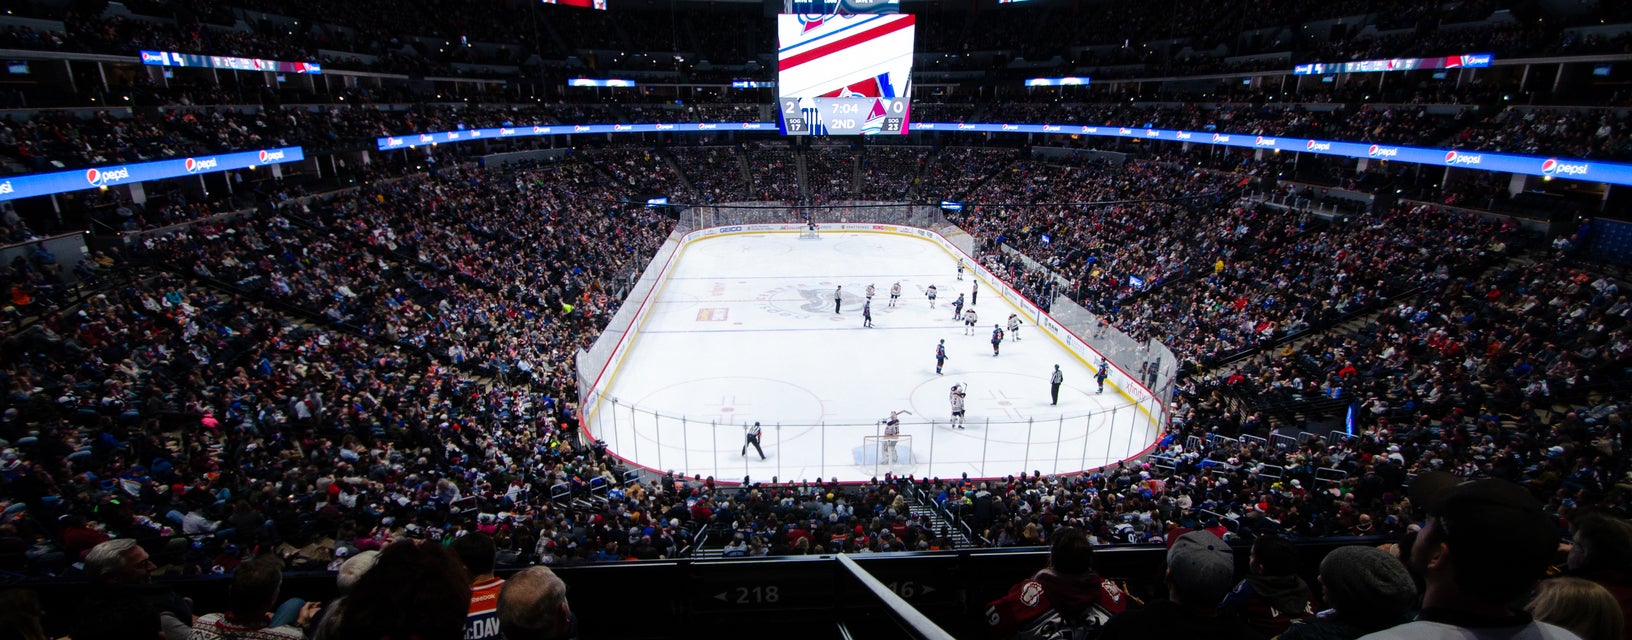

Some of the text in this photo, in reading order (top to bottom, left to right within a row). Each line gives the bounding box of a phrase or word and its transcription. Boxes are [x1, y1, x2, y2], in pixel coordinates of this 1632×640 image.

[786, 101, 795, 114] 2
[831, 104, 858, 114] 7:04
[893, 101, 904, 114] 0
[831, 119, 856, 129] 2ND
[1314, 142, 1330, 151] pepsi
[1377, 147, 1397, 158] pepsi
[196, 157, 217, 170] pepsi
[1456, 153, 1481, 165] pepsi
[102, 167, 129, 183] pepsi
[1556, 162, 1588, 175] pepsi
[1126, 381, 1146, 400] xfinity
[736, 586, 779, 604] 218
